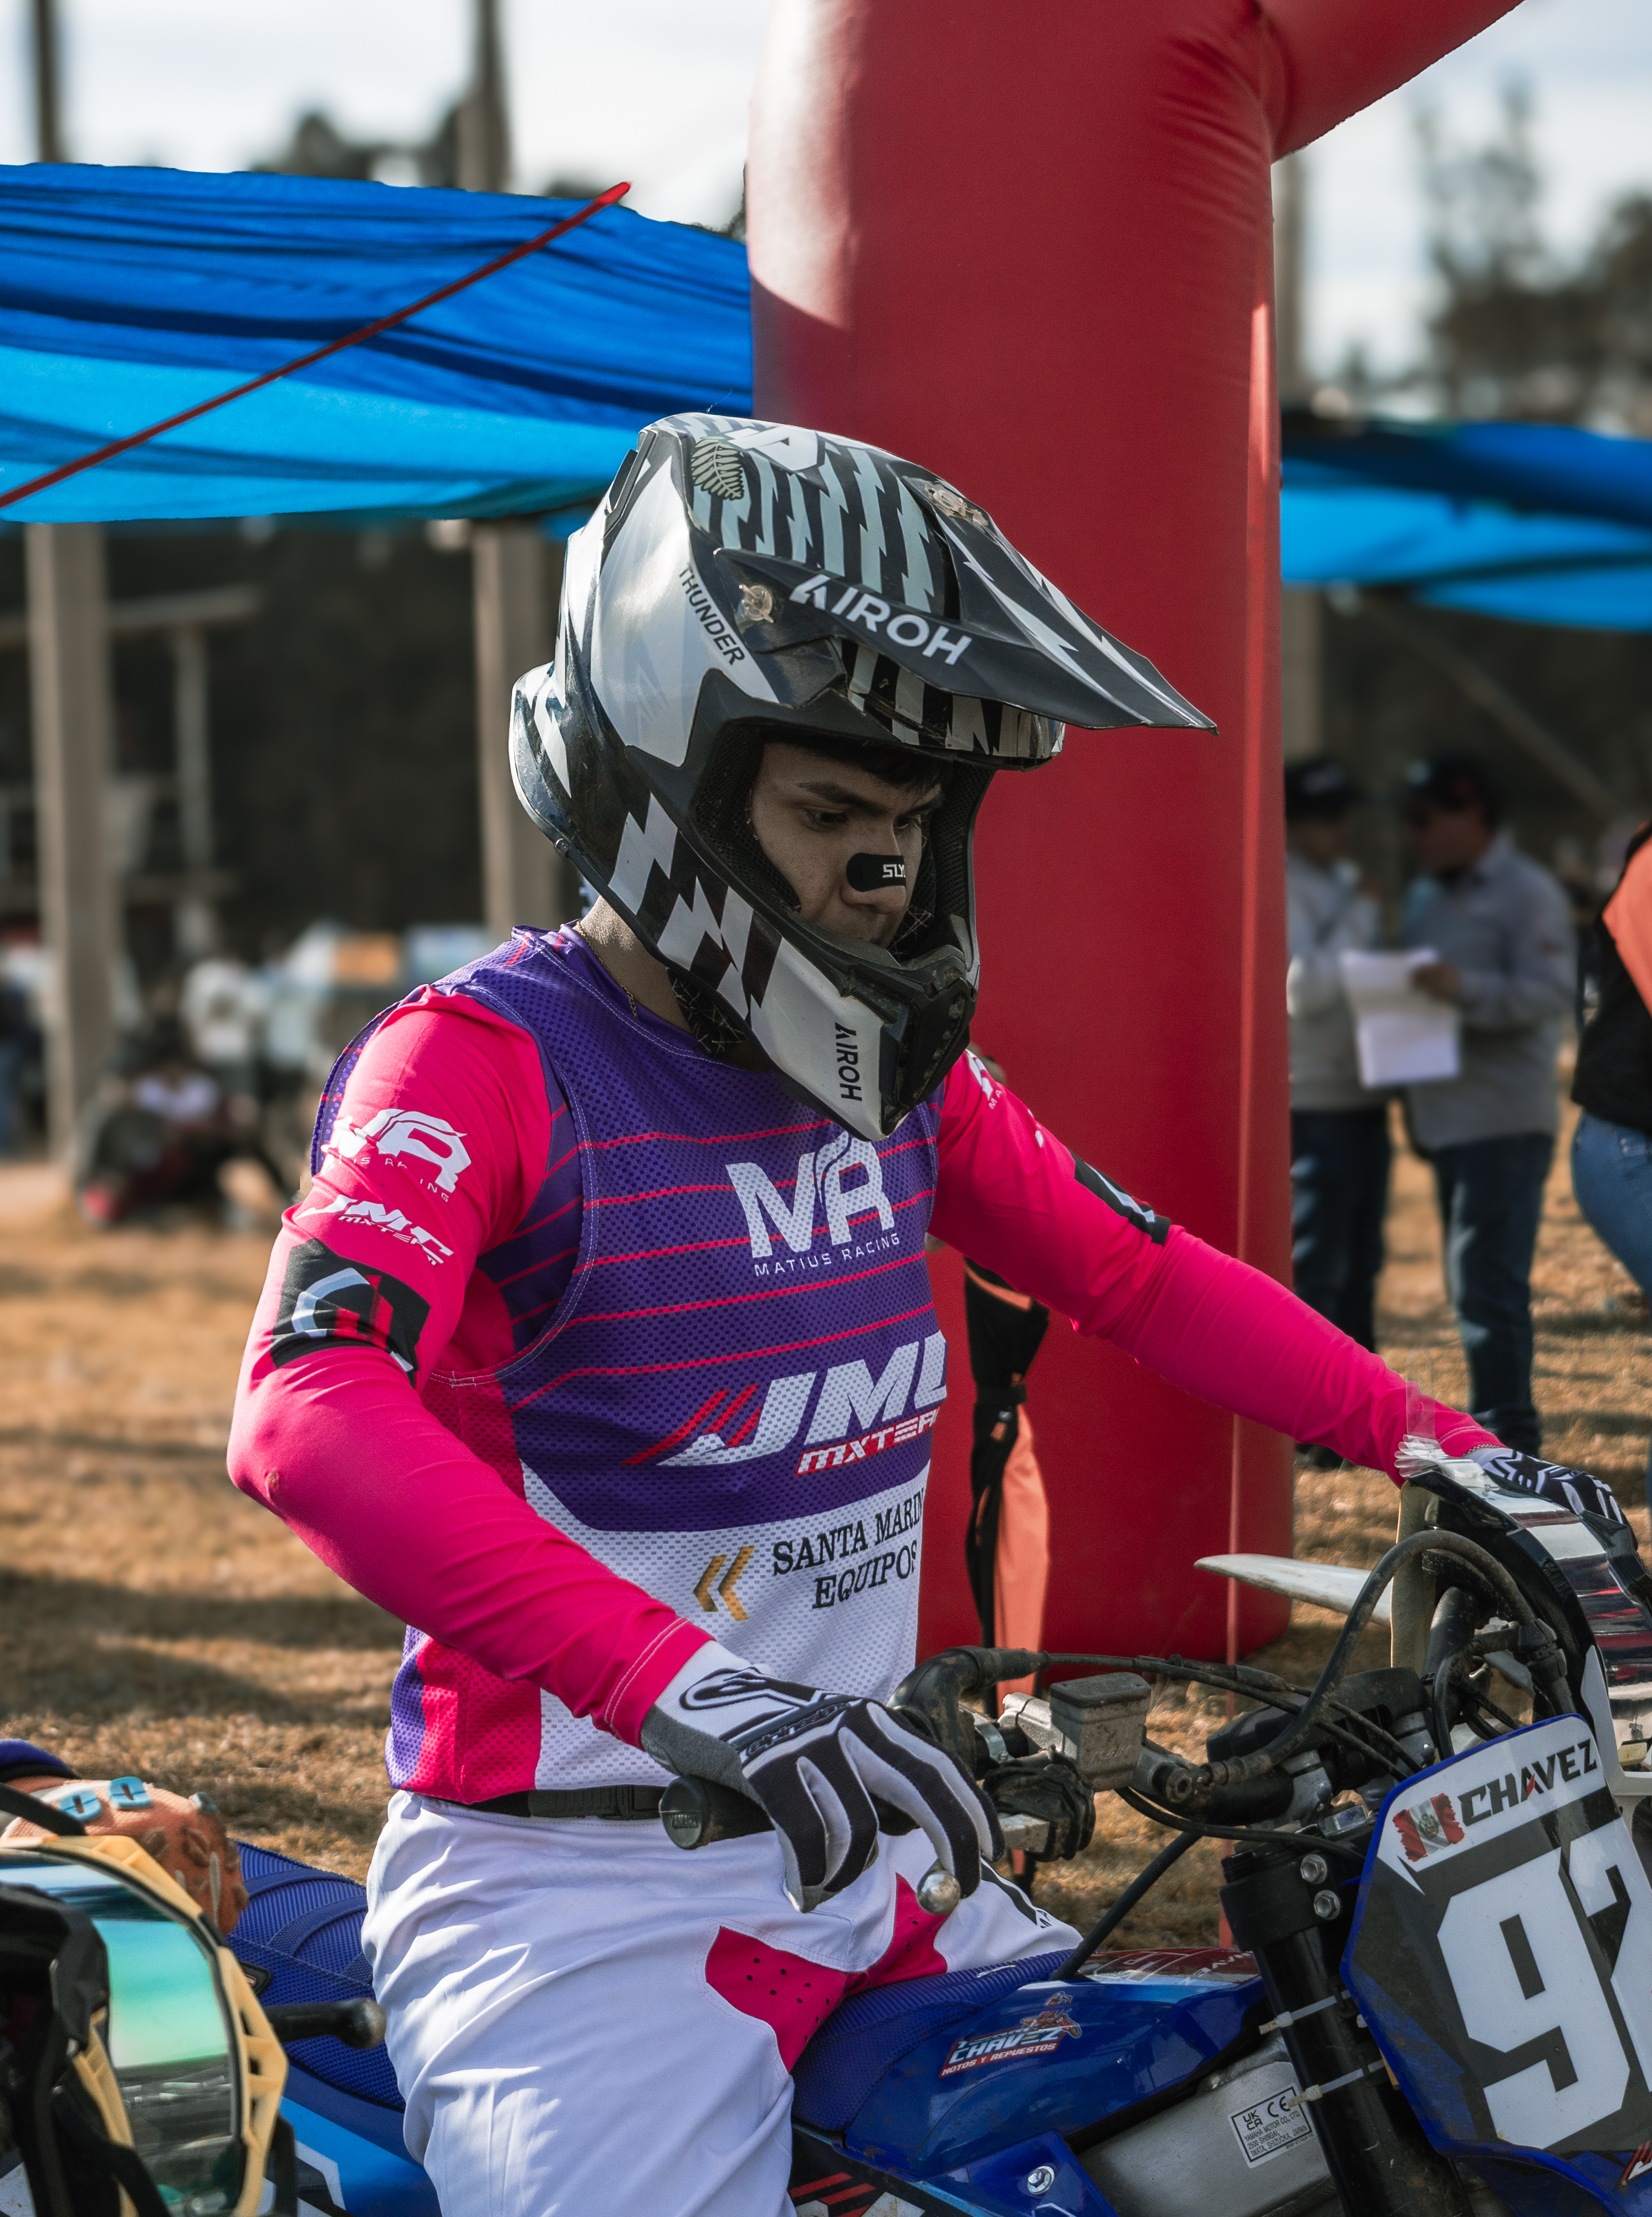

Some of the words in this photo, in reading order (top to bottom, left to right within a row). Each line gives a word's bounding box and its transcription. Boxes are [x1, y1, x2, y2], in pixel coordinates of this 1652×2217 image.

[679, 563, 745, 666] THUNDER
[789, 574, 972, 665] AIROH
[882, 864, 906, 878] SLY
[835, 1021, 862, 1101] AIROH
[754, 1253, 831, 1276] MATIUS
[842, 1233, 900, 1260] RACING
[773, 1520, 868, 1576] SANTA
[812, 1539, 917, 1609] EQUIPOS
[1457, 1739, 1597, 1827] CHAVEZ
[942, 2058, 977, 2076] MOTOS
[990, 2043, 1056, 2060] REPUESTOS
[948, 2027, 1062, 2066] CHAVEZ
[1244, 2129, 1263, 2142] YAMAHA
[1264, 2120, 1280, 2132] MOTOR
[1247, 2139, 1259, 2150] 2500
[1292, 2124, 1307, 2137] JAPAN
